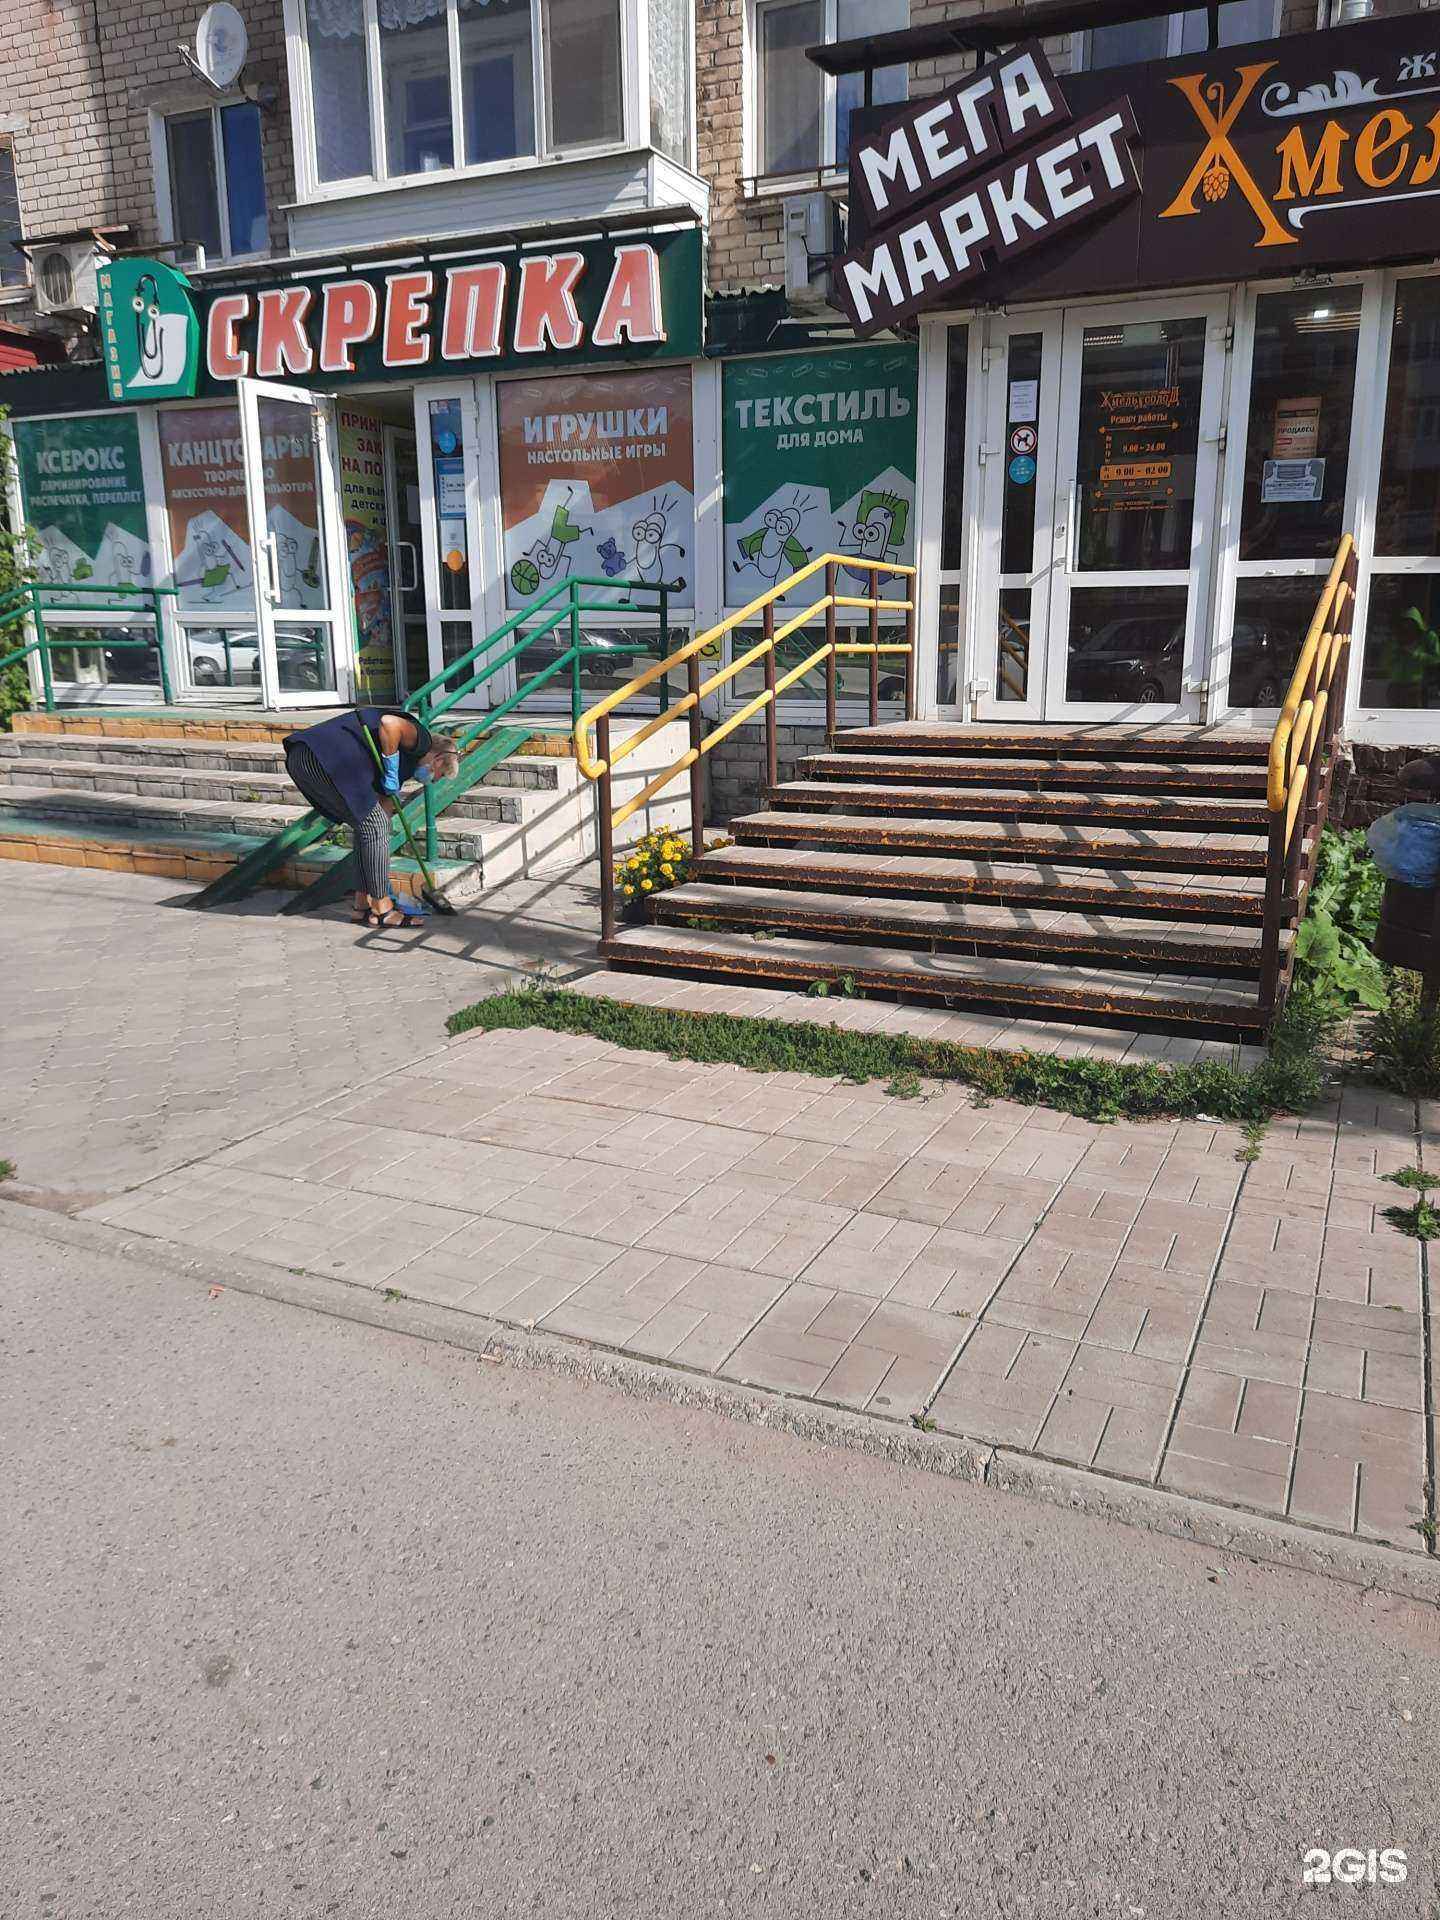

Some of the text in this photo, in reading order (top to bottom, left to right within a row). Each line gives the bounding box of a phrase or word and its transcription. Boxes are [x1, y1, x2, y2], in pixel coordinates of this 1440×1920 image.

[858, 53, 1054, 212] МЕГА
[843, 113, 1127, 324] МАРКЕТ
[207, 243, 667, 381] СКРЕПКА
[100, 274, 123, 397] МАГАЗИН
[341, 412, 381, 432] ПРИН
[523, 406, 668, 444] ИГРУШКИ
[735, 386, 911, 429] ТЕКСТИЛЬ
[168, 433, 310, 467] КАНЦТОАРЫ
[527, 443, 666, 464] НАСТОЛЬНЫЕ ИГРЫ
[776, 428, 864, 450] ДЛЯ ДОМА
[36, 446, 126, 474] КСЕРОКС
